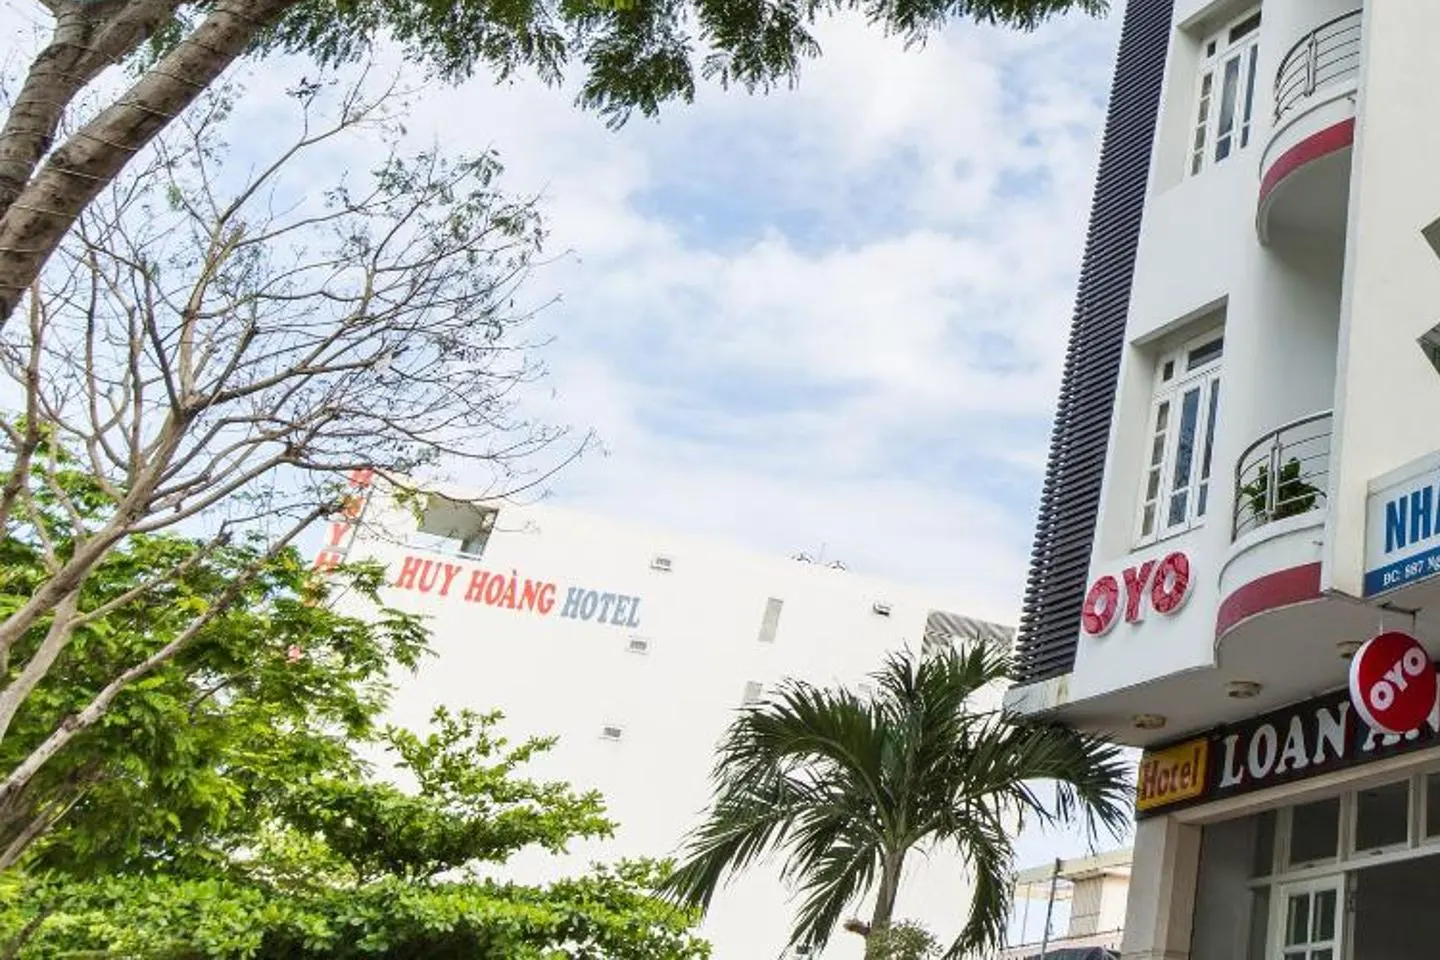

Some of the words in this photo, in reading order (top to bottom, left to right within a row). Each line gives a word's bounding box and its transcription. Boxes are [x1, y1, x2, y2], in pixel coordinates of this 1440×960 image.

[394, 555, 463, 597] HUY
[464, 569, 557, 616] HOÀNG
[560, 587, 643, 629] HOTEL
[1081, 550, 1194, 637] OYO
[1370, 646, 1427, 711] OYO
[1140, 743, 1204, 801] Hotel
[1219, 700, 1351, 789] LOAN
